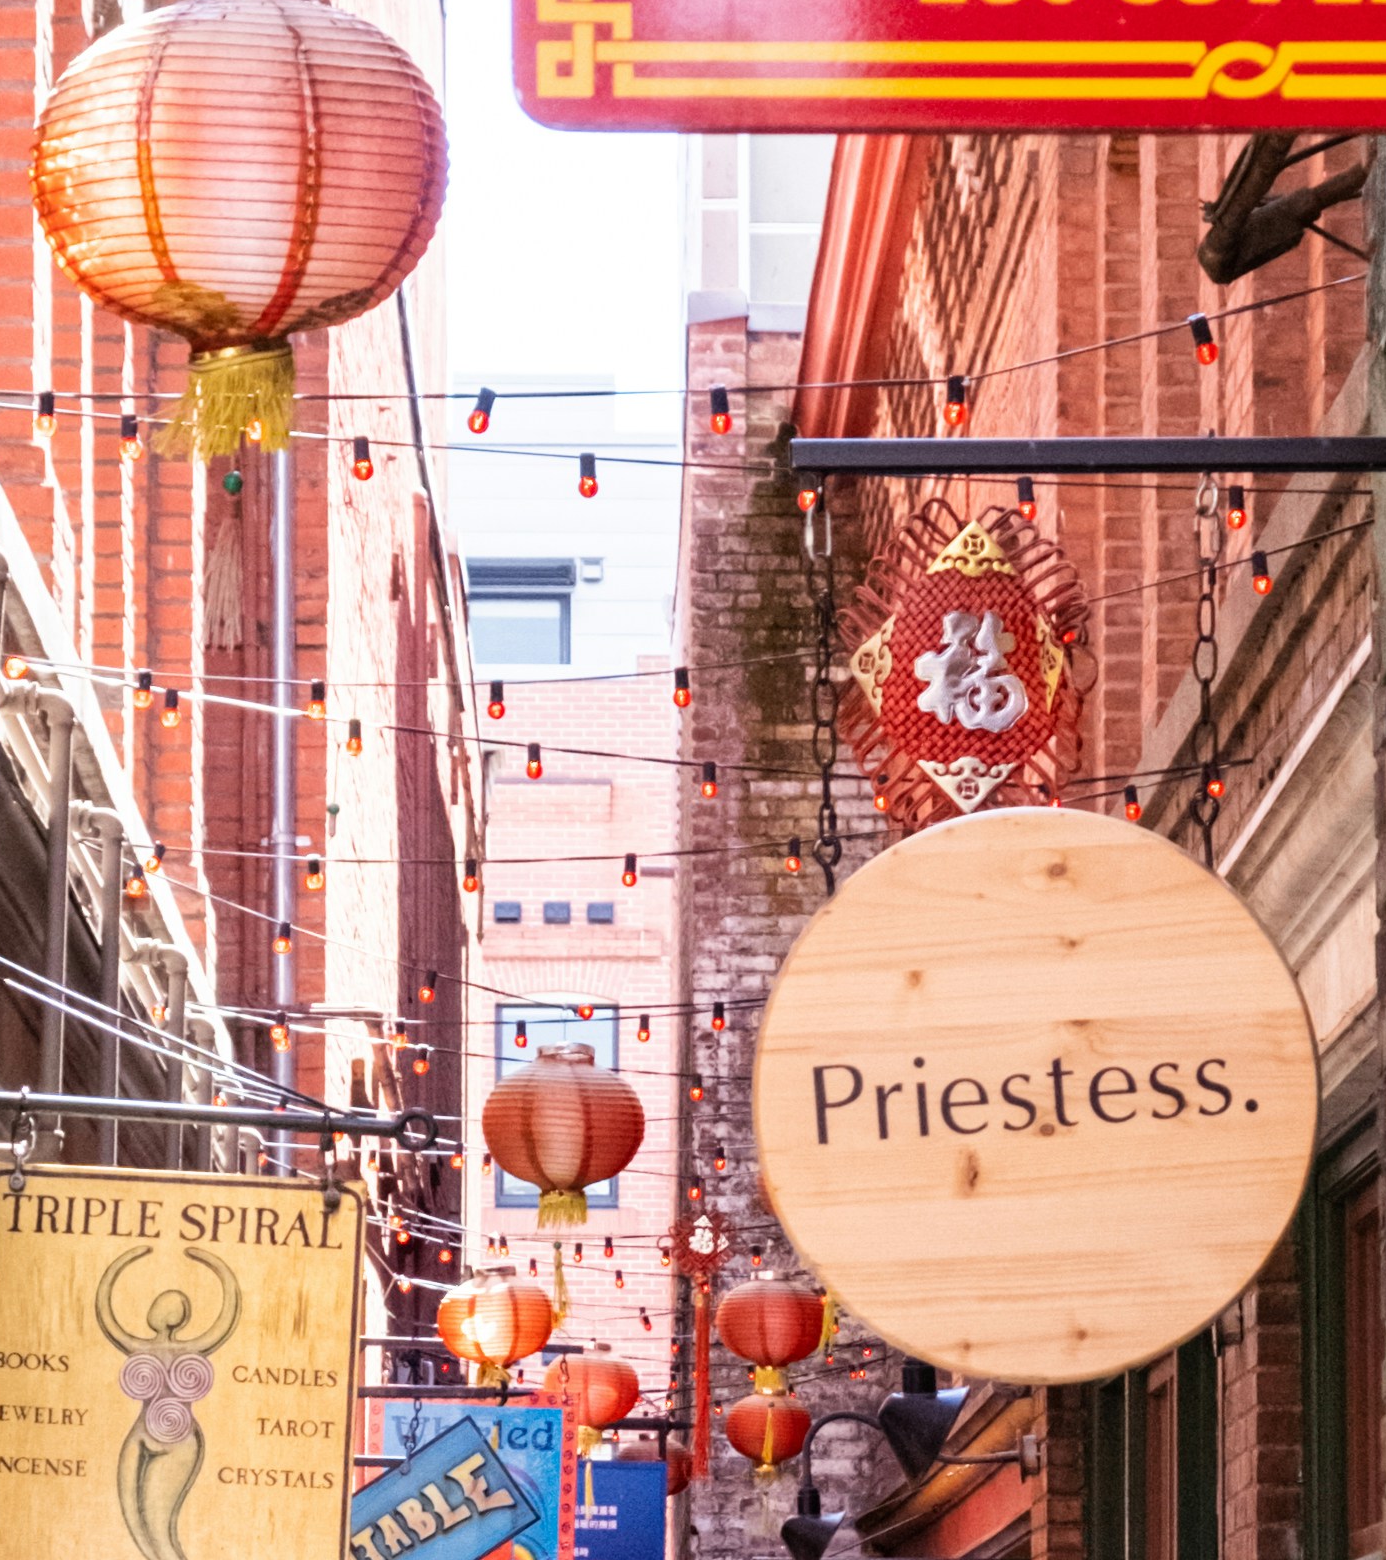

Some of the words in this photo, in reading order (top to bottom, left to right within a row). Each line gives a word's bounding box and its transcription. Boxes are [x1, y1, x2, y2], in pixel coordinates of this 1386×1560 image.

[914, 609, 1029, 733] 福
[813, 1056, 1259, 1144] Priestess.
[2, 1193, 164, 1239] TRIPLE
[179, 1203, 343, 1250] SPIRAL
[232, 1365, 338, 1387] CANDLES
[256, 1417, 336, 1439] TAROT
[217, 1466, 335, 1489] CRYSTALS
